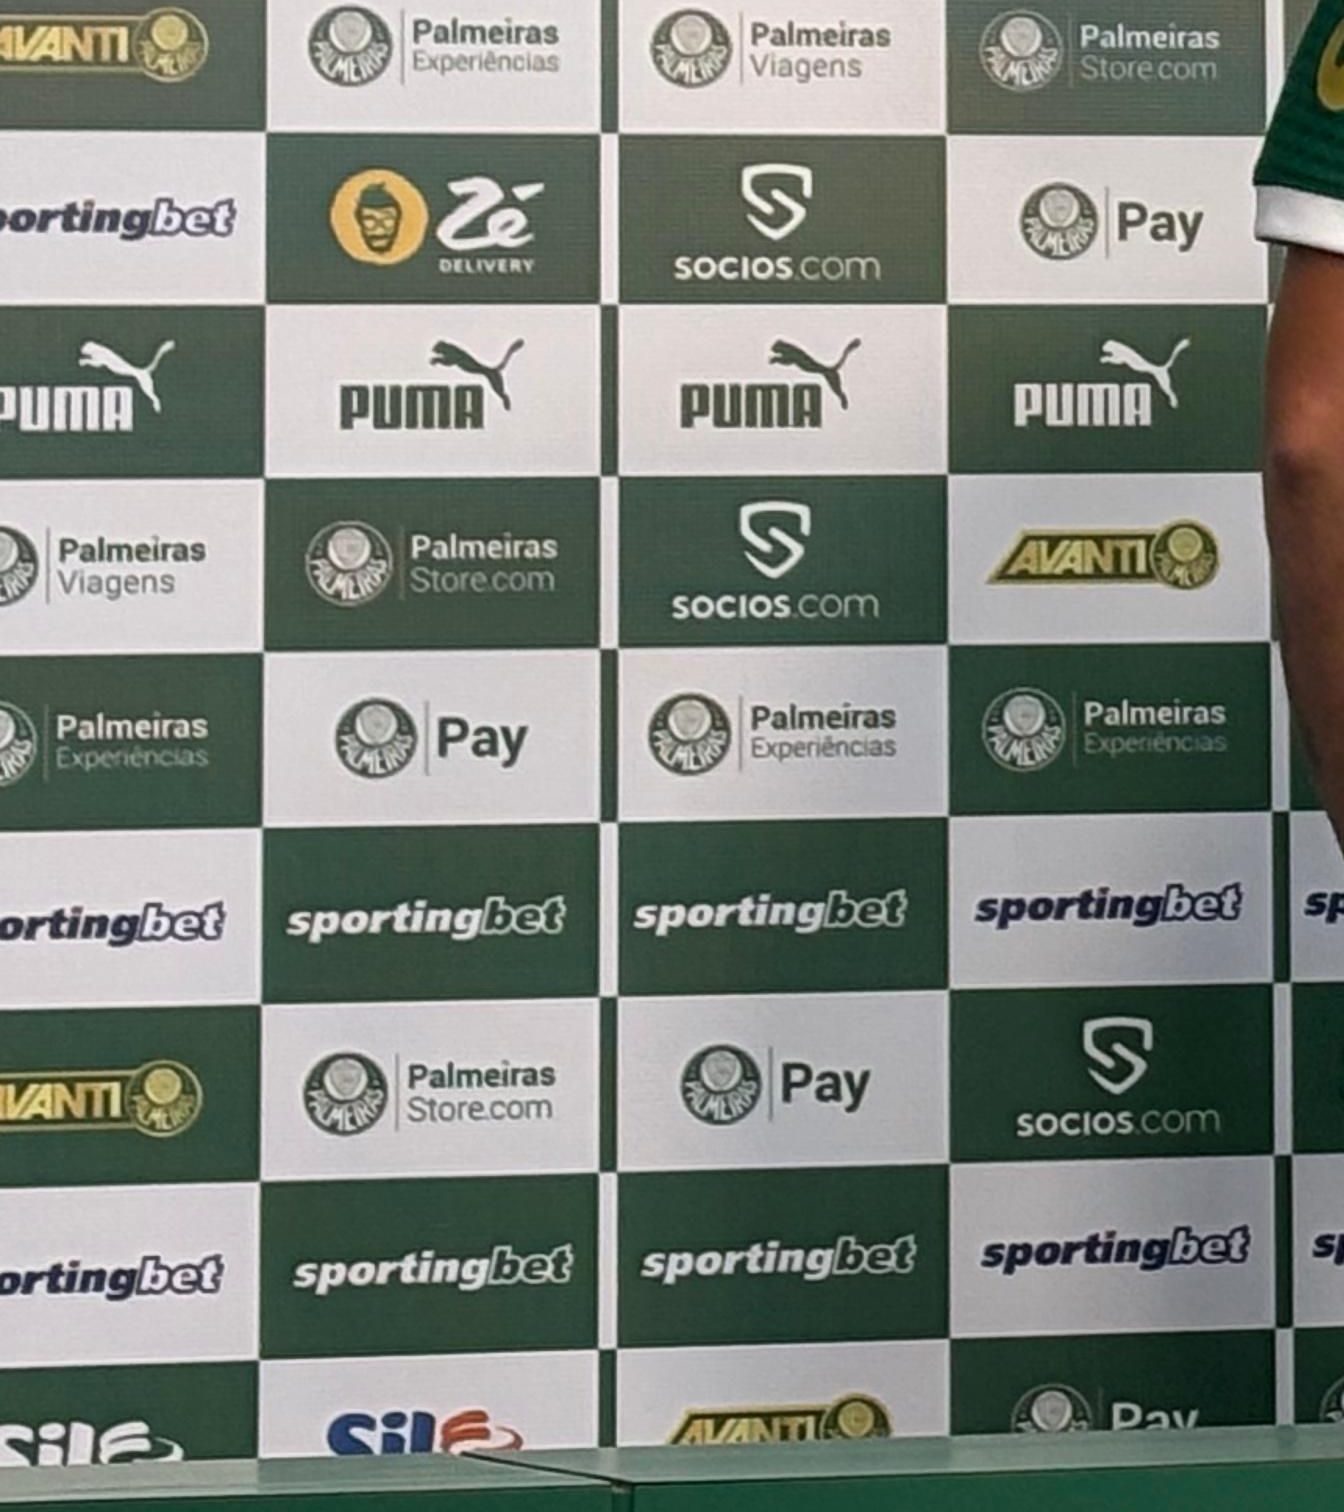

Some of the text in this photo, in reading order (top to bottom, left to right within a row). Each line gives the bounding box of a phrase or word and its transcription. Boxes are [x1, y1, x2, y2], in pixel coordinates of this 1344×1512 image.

[413, 18, 559, 44] Palmeiras
[752, 21, 891, 47] Palmeiras
[1081, 24, 1220, 49] Palmeiras
[413, 50, 559, 76] Experiências
[750, 54, 862, 84] Viagens
[1081, 55, 1217, 81] Store.com
[1119, 202, 1203, 252] Pay
[439, 258, 534, 273] DELIVERY
[340, 385, 484, 430] PUMA
[681, 384, 822, 428] PUMA
[1014, 383, 1151, 426] PUMA
[59, 537, 206, 562] Palmeiras
[412, 533, 557, 559] Palmeiras
[1006, 538, 1146, 574] AVANTI
[57, 570, 175, 599] Viagens
[410, 566, 555, 593] Store.com
[752, 703, 896, 730] Palmeiras
[1085, 699, 1225, 725] Palmeiras
[57, 713, 208, 740] Palmeiras
[438, 717, 528, 768] Pay
[752, 736, 897, 762] Experiências
[287, 896, 566, 943] sportingbet
[634, 890, 907, 936] sportingbet
[976, 882, 1243, 929] sportingbet
[409, 1061, 555, 1089] Palmeiras
[782, 1063, 870, 1113] Pay
[408, 1096, 552, 1122] Store.com
[641, 1235, 916, 1284] sportingbet
[982, 1225, 1251, 1275] sportingbet
[294, 1244, 573, 1295] sportingbet
